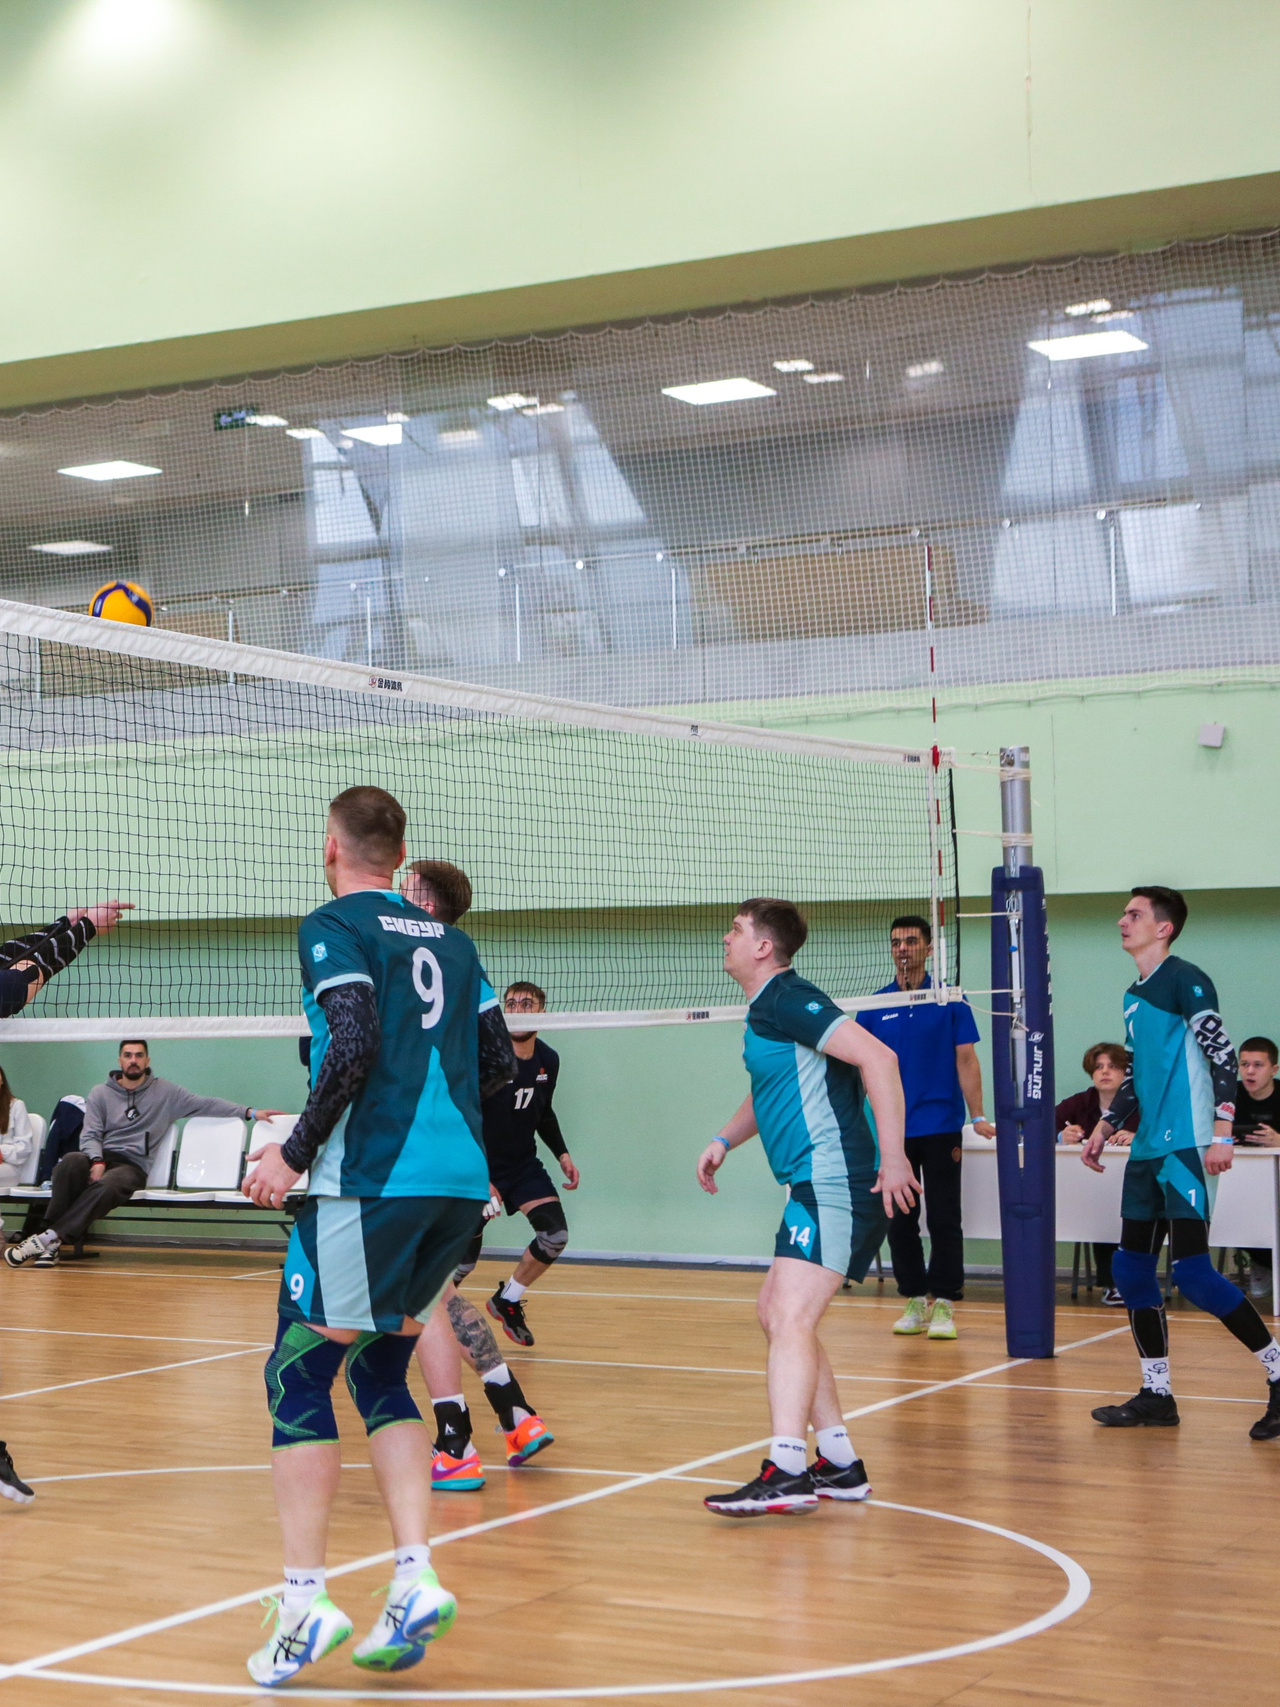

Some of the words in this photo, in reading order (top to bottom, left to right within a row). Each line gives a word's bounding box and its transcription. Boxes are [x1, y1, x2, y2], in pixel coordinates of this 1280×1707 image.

[377, 915, 445, 938] СИБУР
[412, 946, 444, 1030] 9
[1032, 1045, 1043, 1100] JINLING
[514, 1087, 535, 1110] 17
[1187, 1188, 1196, 1207] 1
[789, 1225, 811, 1247] 14
[290, 1273, 305, 1302] 9
